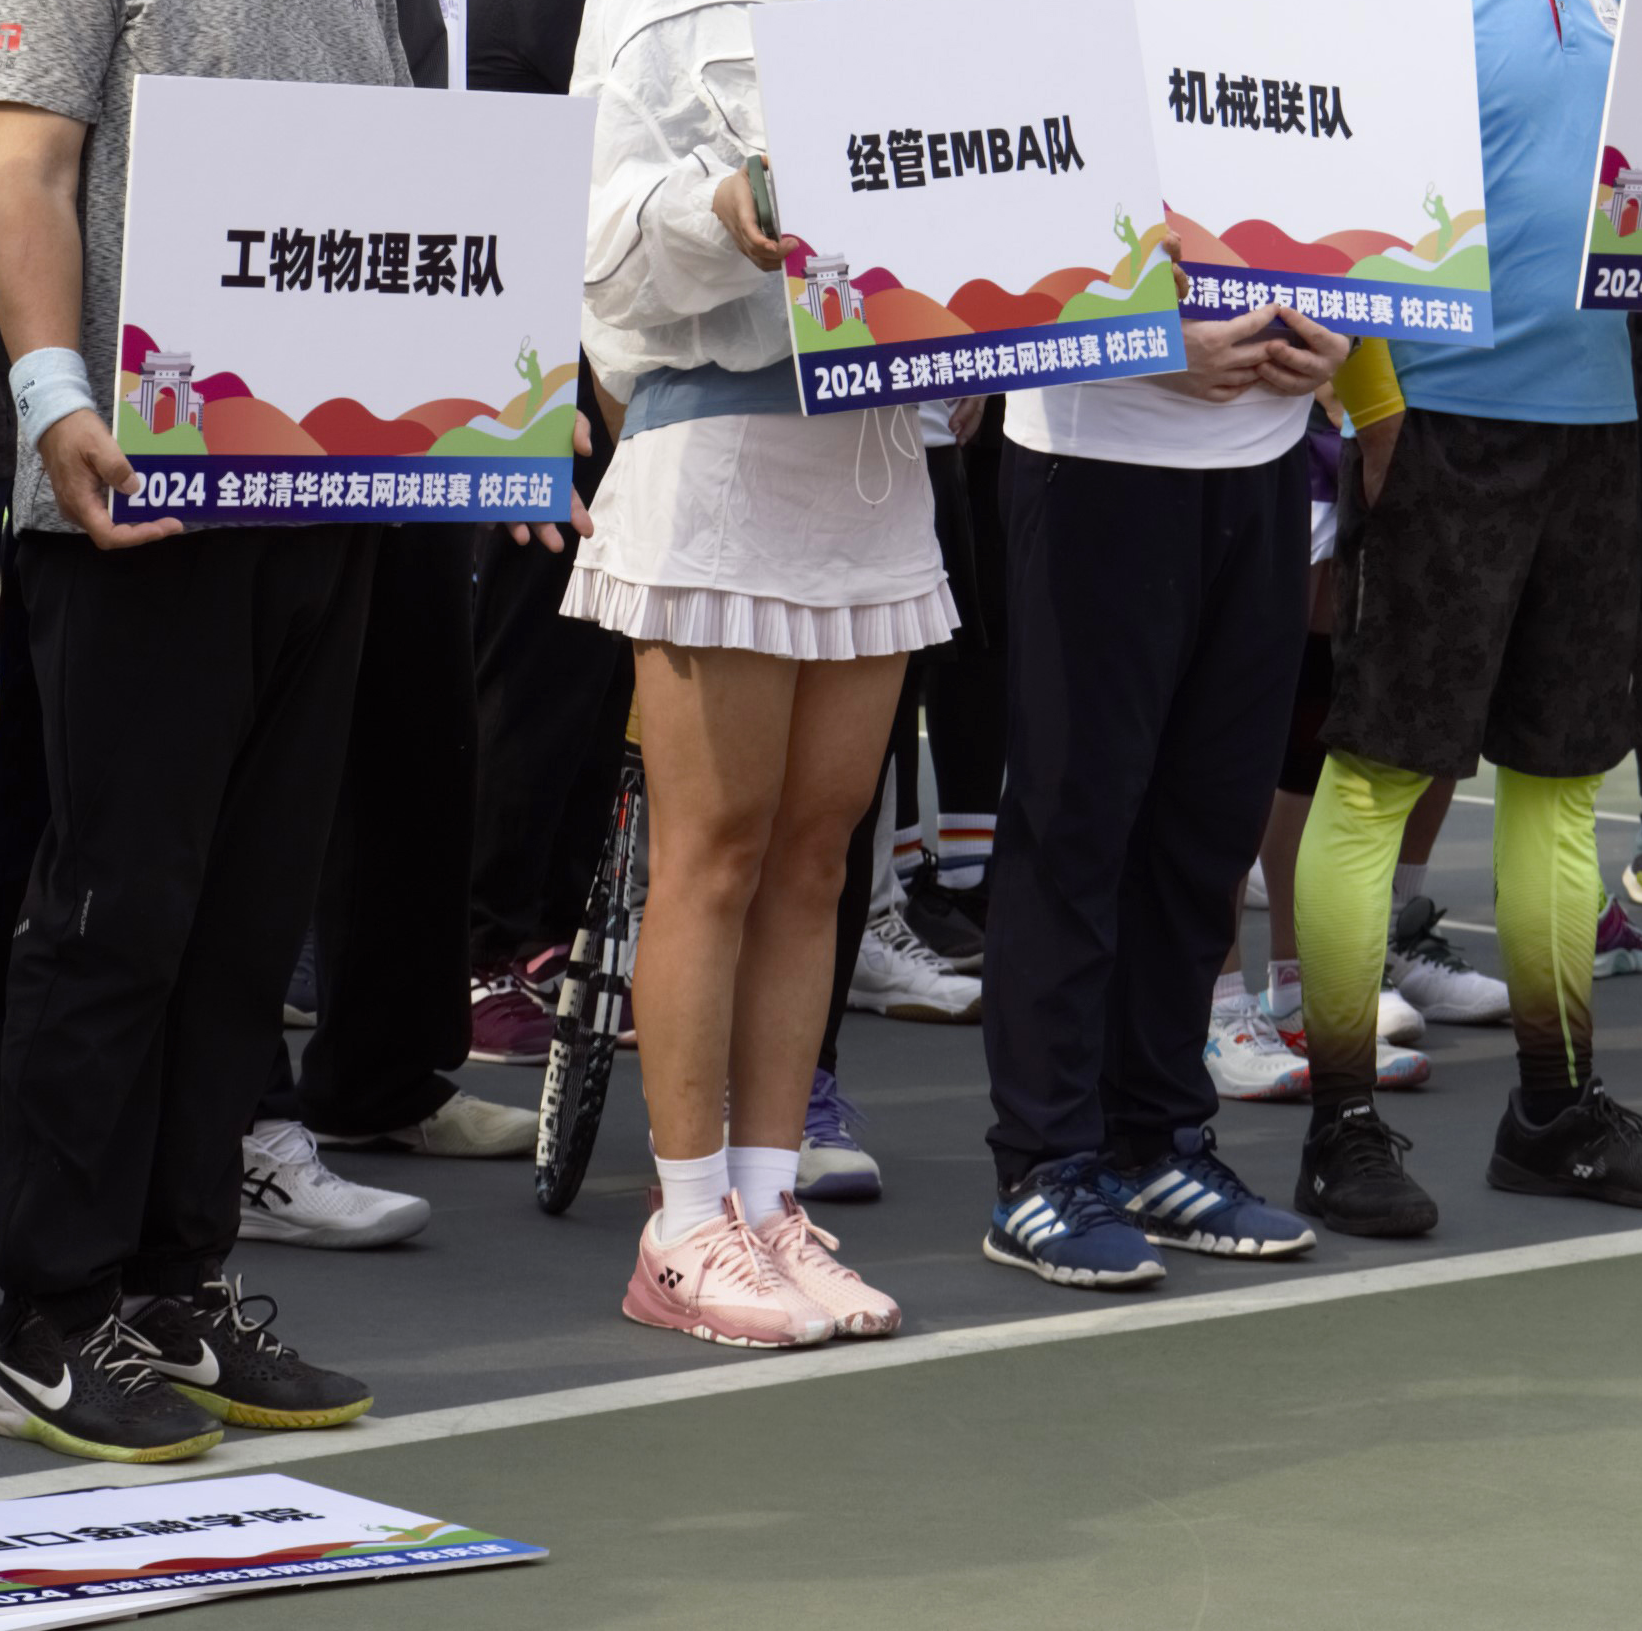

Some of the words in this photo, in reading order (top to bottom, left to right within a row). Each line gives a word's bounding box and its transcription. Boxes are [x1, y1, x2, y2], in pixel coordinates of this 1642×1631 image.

[1168, 67, 1354, 141] 机械联队
[847, 115, 1085, 193] 经管EMBA队
[221, 227, 505, 297] 工物物理系队
[1401, 296, 1474, 333] 校庆站
[814, 363, 882, 400] 2024
[889, 335, 1102, 392] 全球清华校友网球联赛
[1106, 326, 1169, 362] 校庆站
[128, 471, 206, 508] 2024
[217, 472, 471, 508] 全球清华校友网球联赛
[478, 473, 554, 508] 校庆站
[77, 1553, 406, 1597] 全球清华校友网球联赛
[408, 1541, 511, 1563] 校庆站
